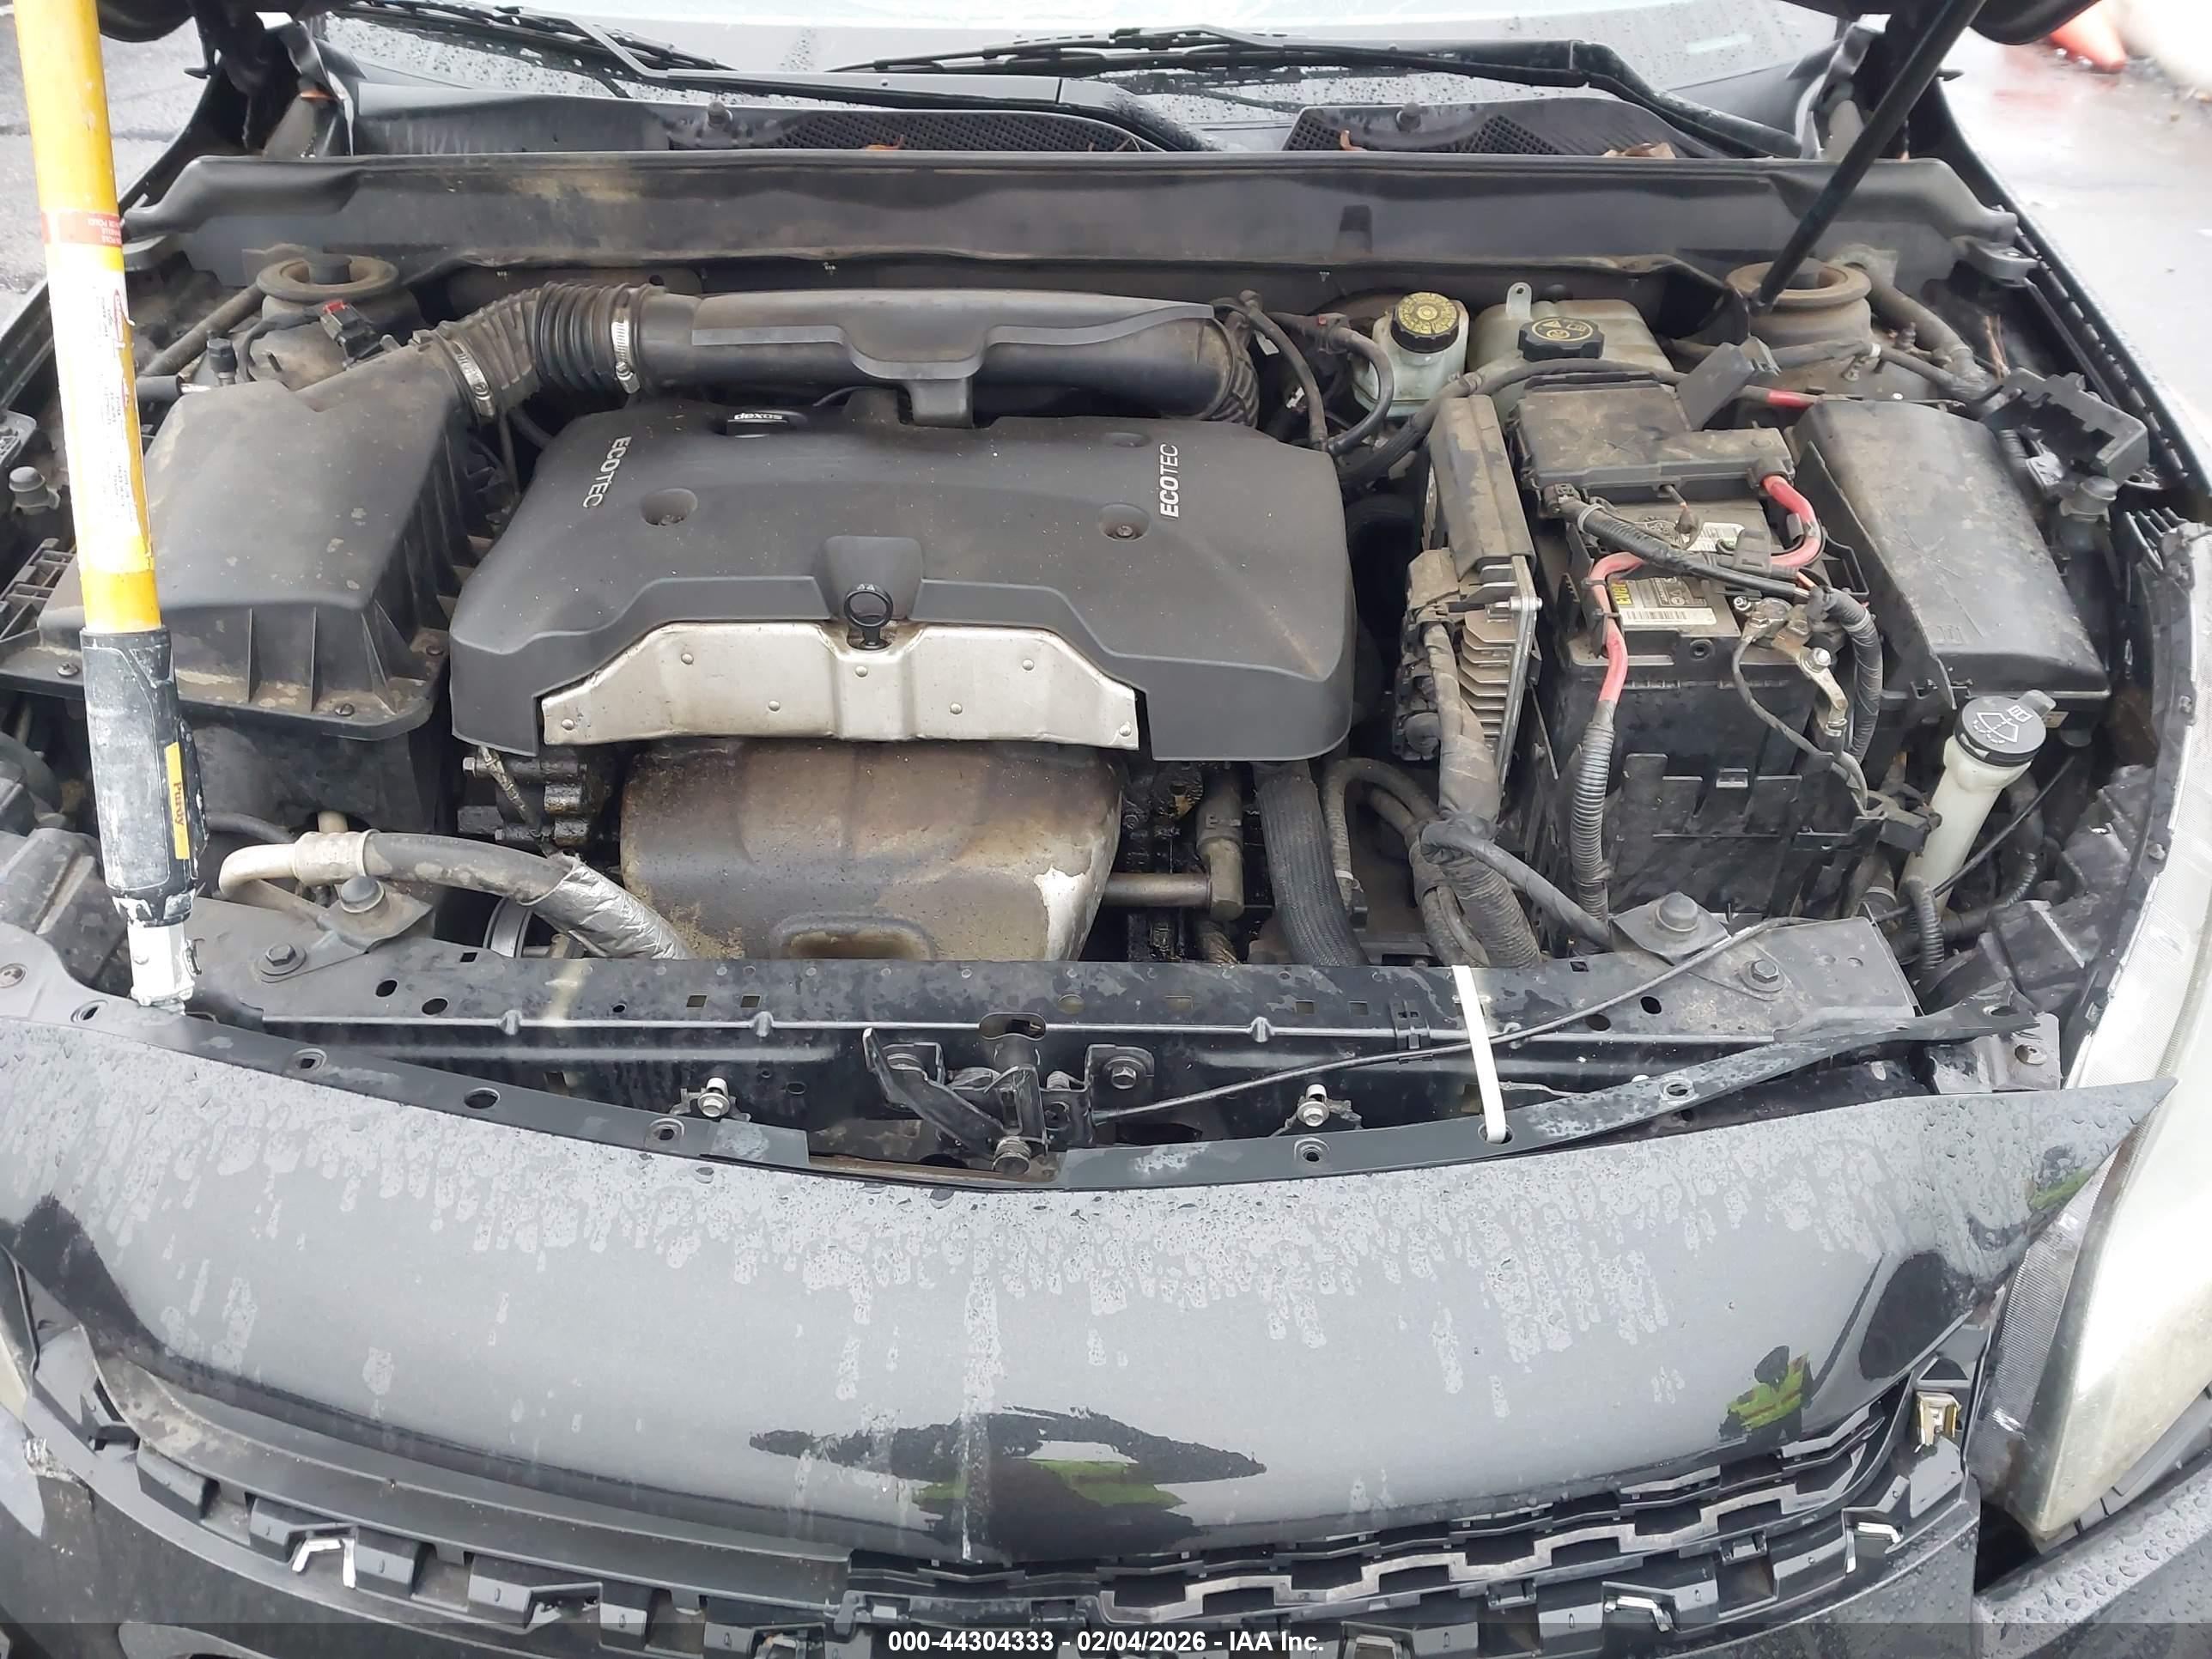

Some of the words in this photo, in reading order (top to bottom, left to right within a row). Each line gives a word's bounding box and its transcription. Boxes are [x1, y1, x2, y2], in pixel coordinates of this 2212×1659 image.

[582, 436, 633, 508] ECOTEC
[1159, 443, 1179, 518] ECOTEC
[173, 782, 185, 826] Purdy
